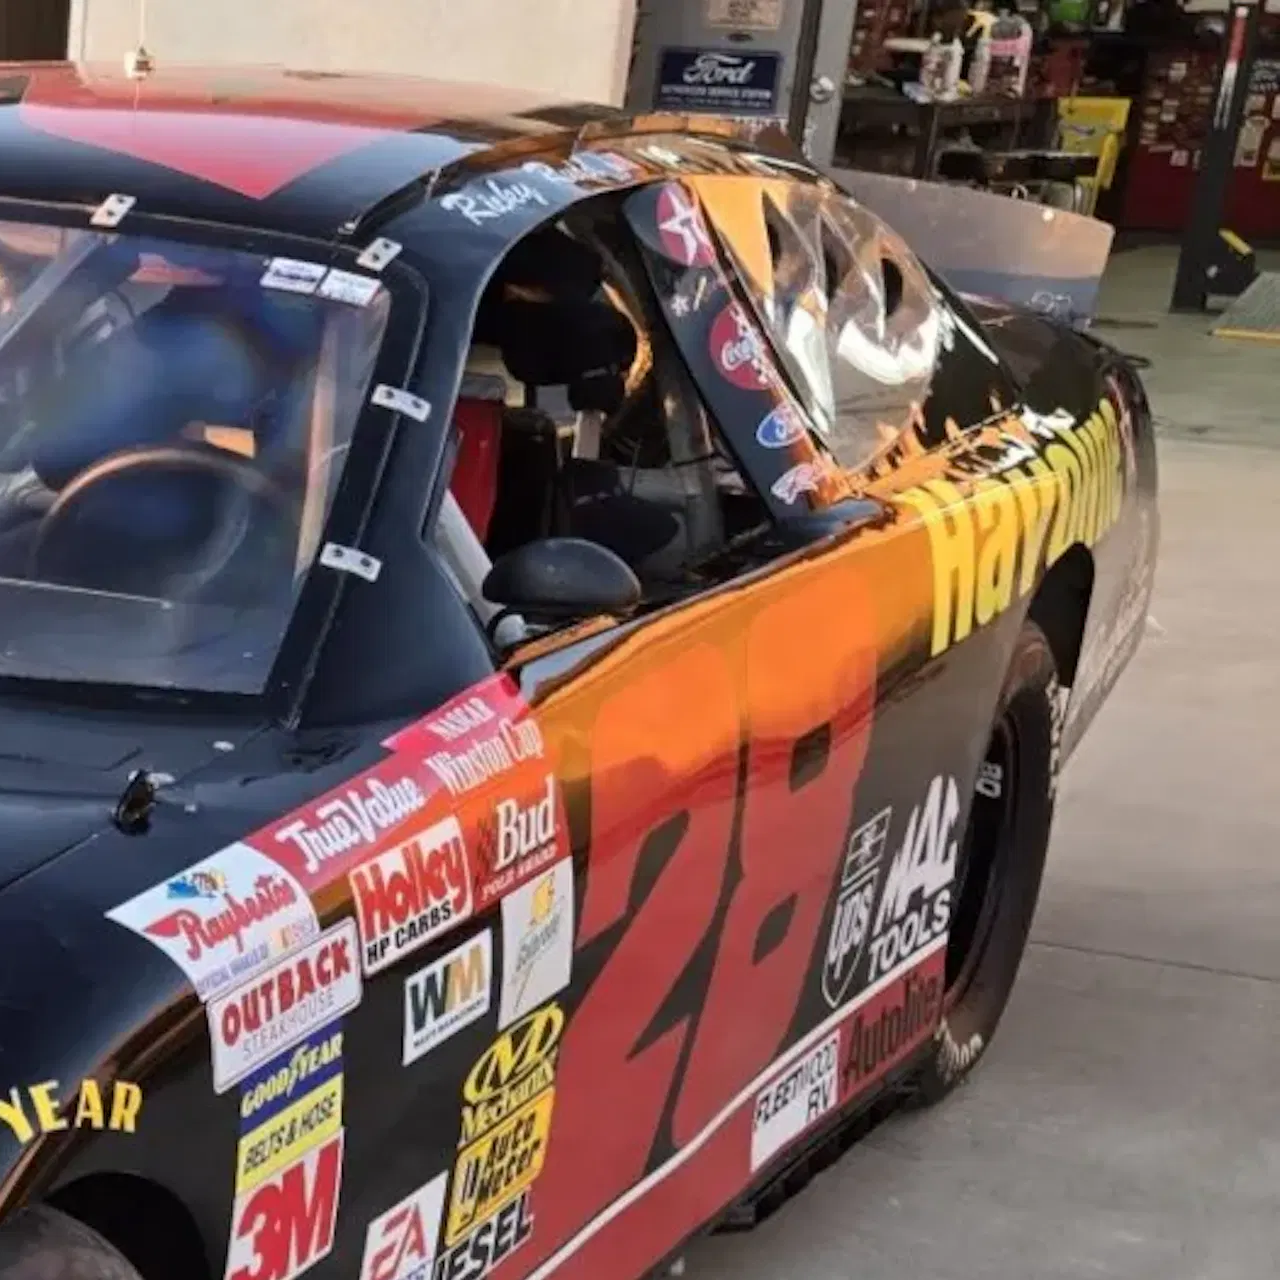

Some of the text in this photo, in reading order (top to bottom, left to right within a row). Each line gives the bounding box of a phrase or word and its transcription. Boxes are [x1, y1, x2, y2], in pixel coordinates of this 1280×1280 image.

[682, 52, 757, 85] Ford
[424, 716, 545, 796] Winston Cup
[426, 697, 495, 742] NASCAR
[494, 772, 556, 872] Bud
[872, 774, 960, 938] MAC
[351, 836, 462, 941] Holley
[366, 900, 453, 966] HP CARBS
[868, 889, 951, 982] TOOLS
[222, 937, 350, 1047] OUTBACK
[243, 987, 335, 1062] STEAKHOUSE
[842, 968, 941, 1098] Autolite
[241, 1031, 344, 1118] GOODYEAR
[754, 1038, 837, 1129] FLEETWOOD
[806, 1074, 834, 1123] RV
[243, 1089, 338, 1175] BELTS & HOSE
